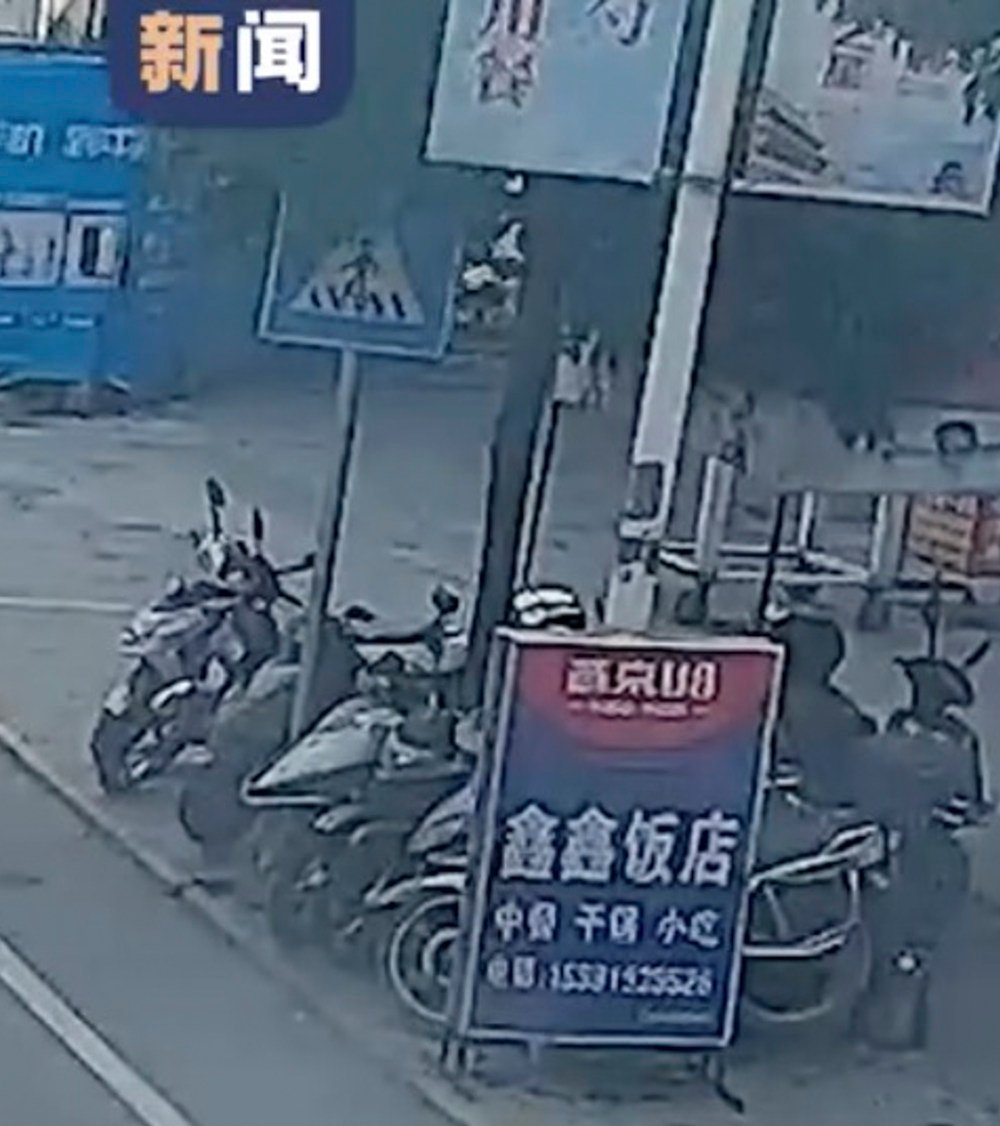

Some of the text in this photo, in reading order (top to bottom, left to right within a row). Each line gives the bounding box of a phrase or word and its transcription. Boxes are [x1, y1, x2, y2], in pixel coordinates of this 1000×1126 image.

[501, 803, 742, 886] 鑫鑫饭店
[657, 907, 720, 948] 小吃
